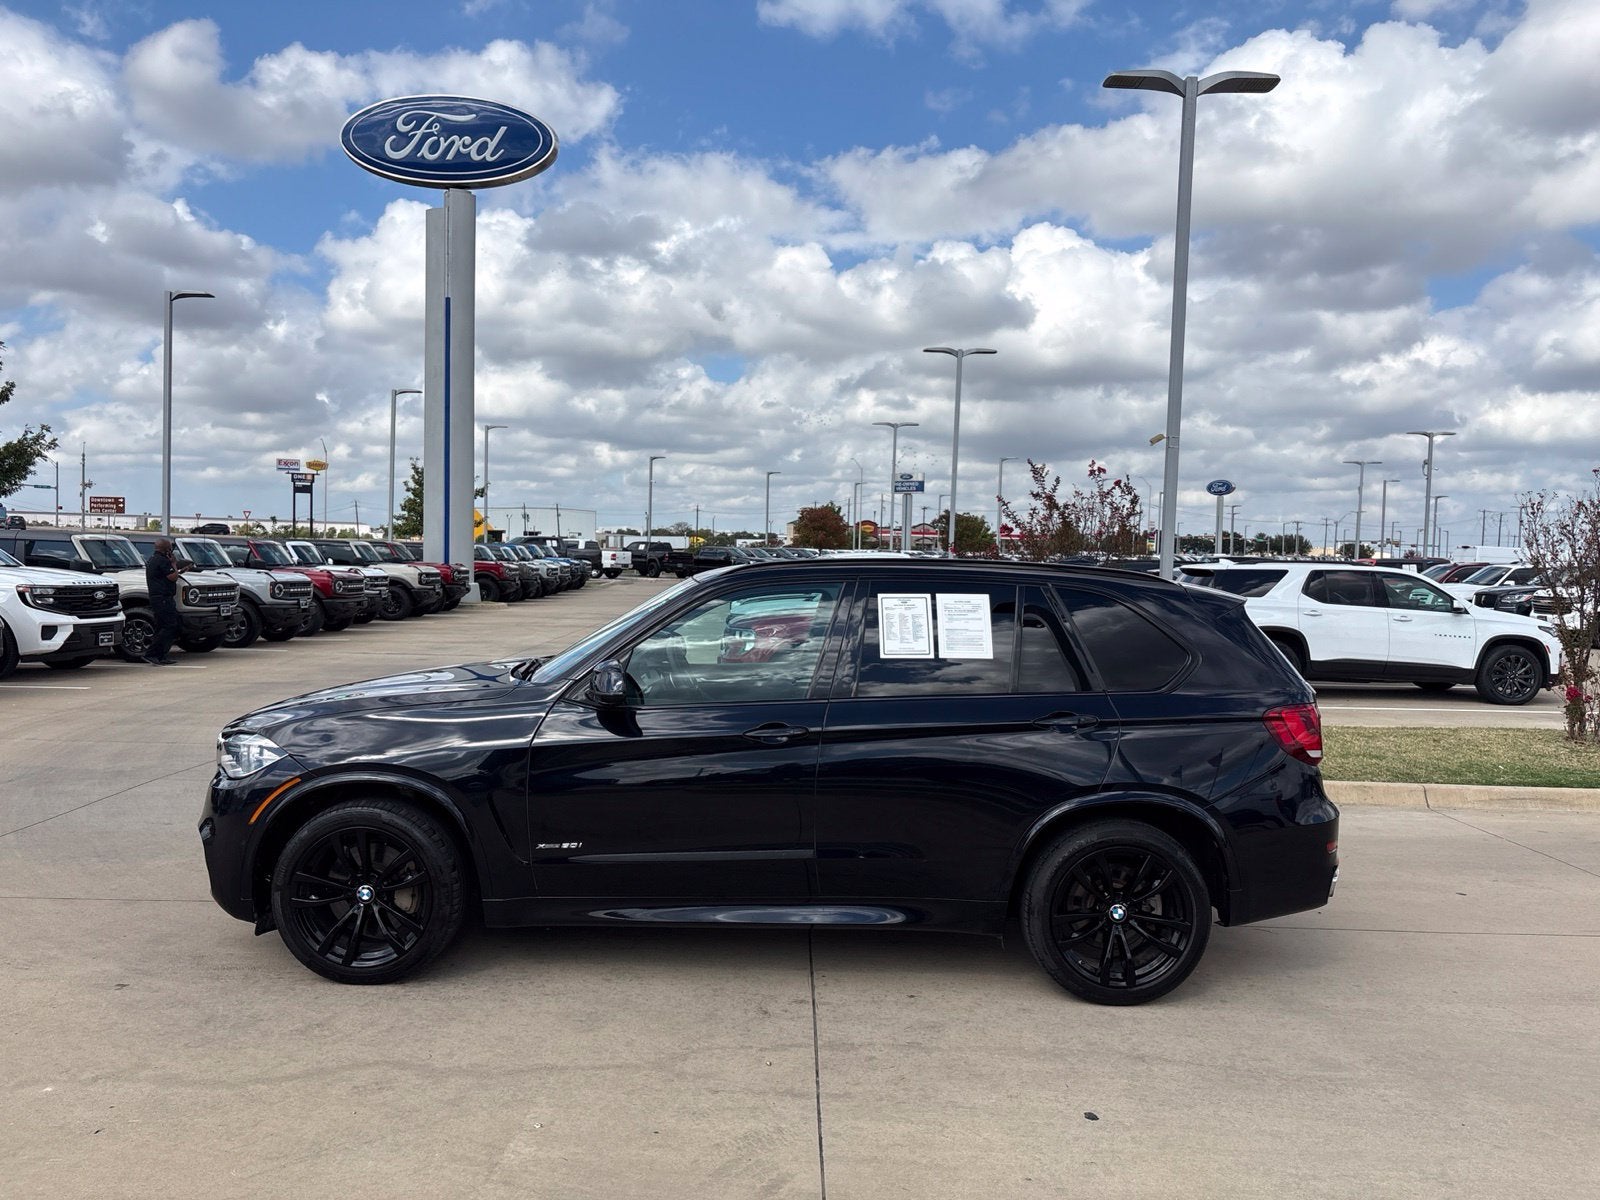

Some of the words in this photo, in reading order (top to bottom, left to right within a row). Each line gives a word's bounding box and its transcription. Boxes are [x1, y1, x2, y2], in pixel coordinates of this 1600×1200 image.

[384, 109, 508, 162] Ford
[278, 459, 299, 467] Exxon
[1210, 482, 1228, 492] Ford
